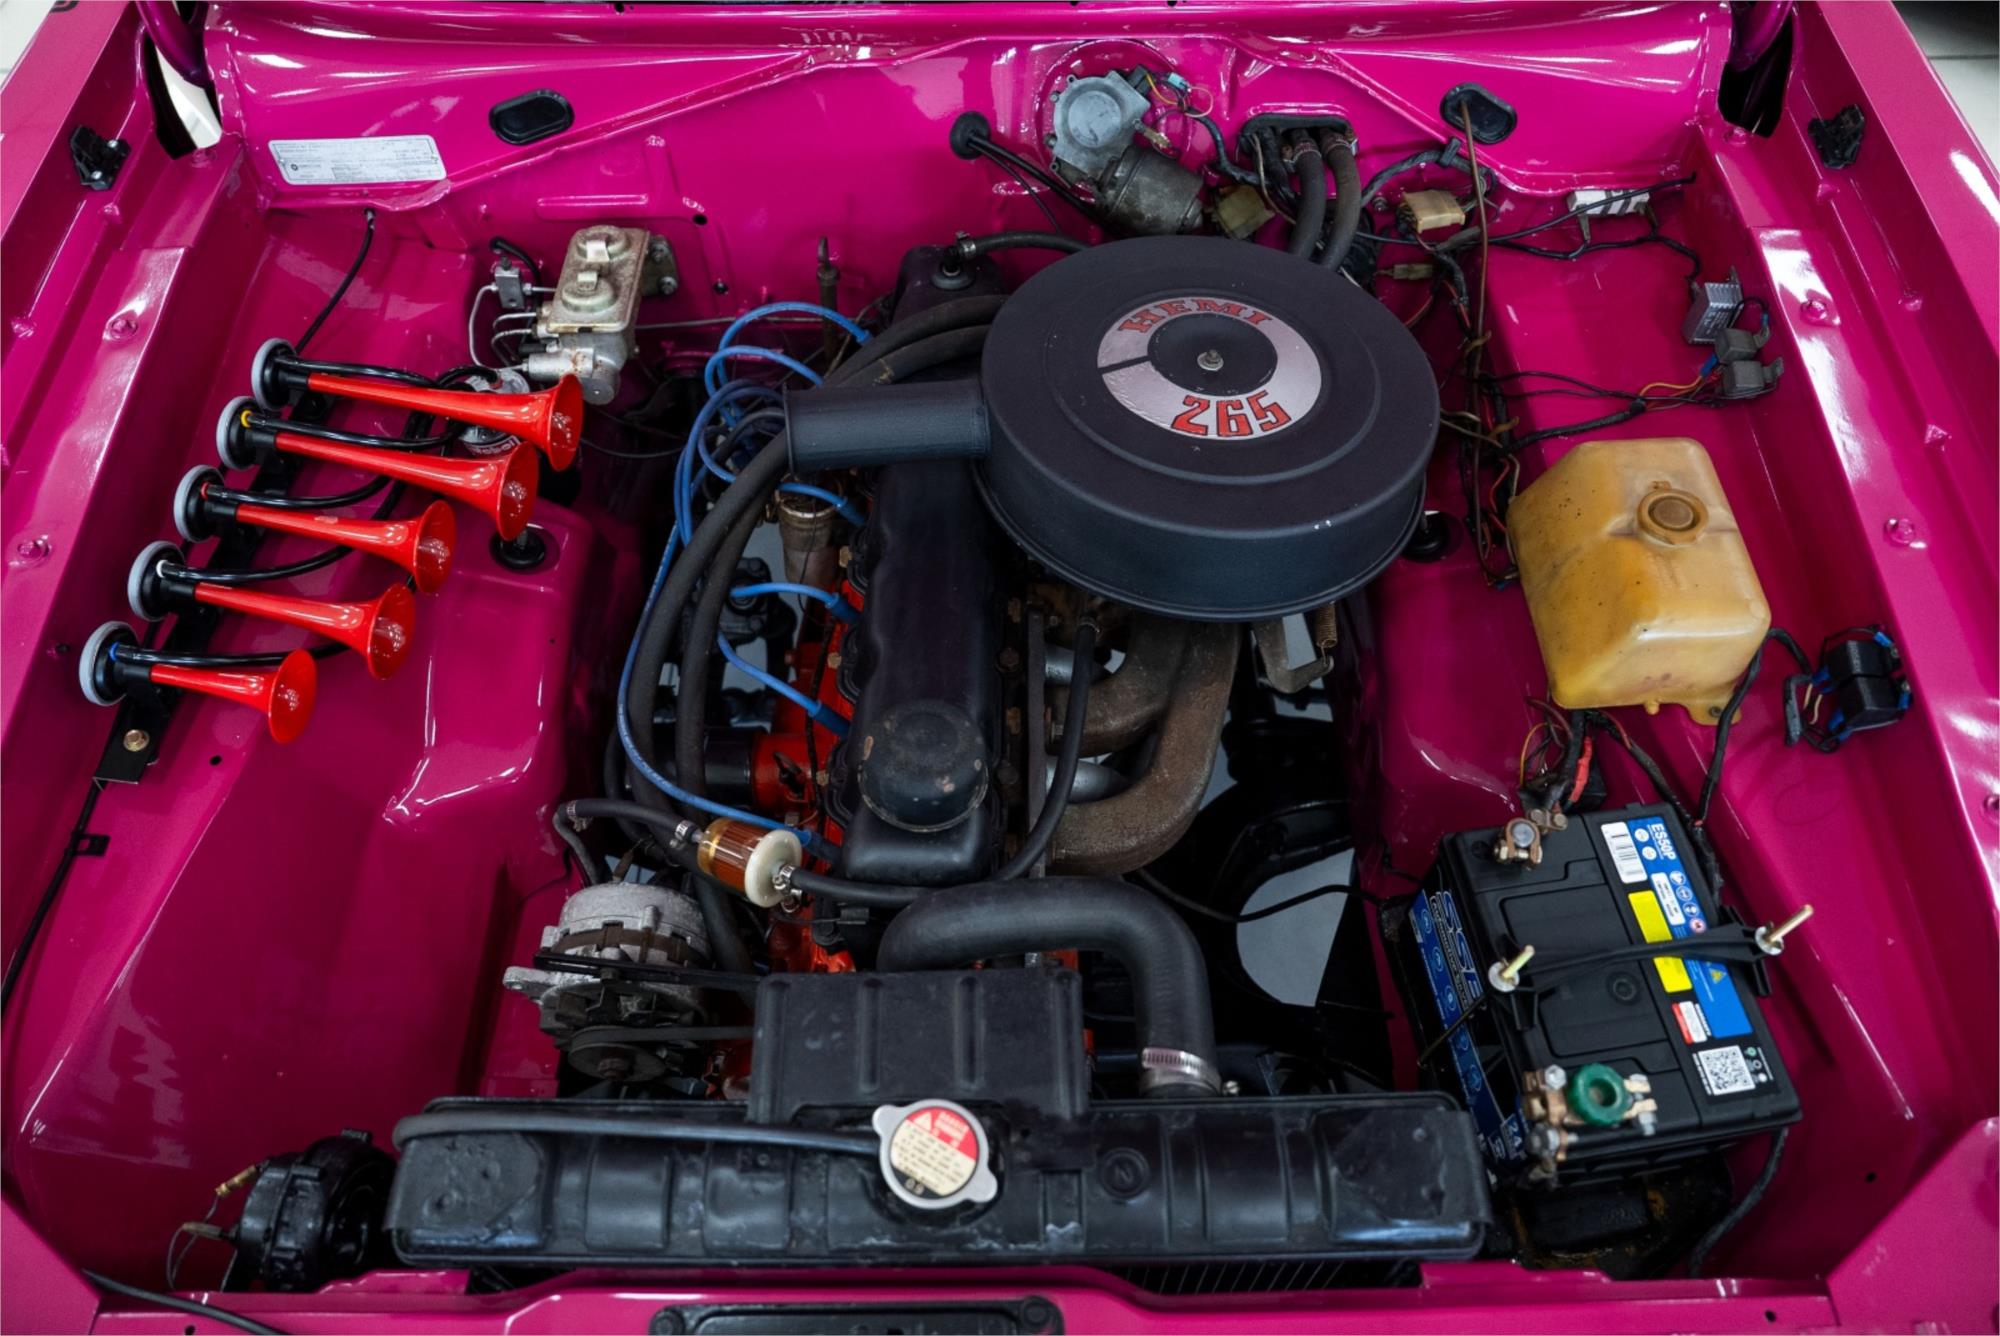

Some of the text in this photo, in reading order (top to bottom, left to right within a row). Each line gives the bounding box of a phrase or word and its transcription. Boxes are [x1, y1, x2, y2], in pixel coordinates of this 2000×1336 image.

[1117, 299, 1273, 333] HEMI
[1171, 390, 1292, 437] 265
[1651, 823, 1677, 860] ES50P
